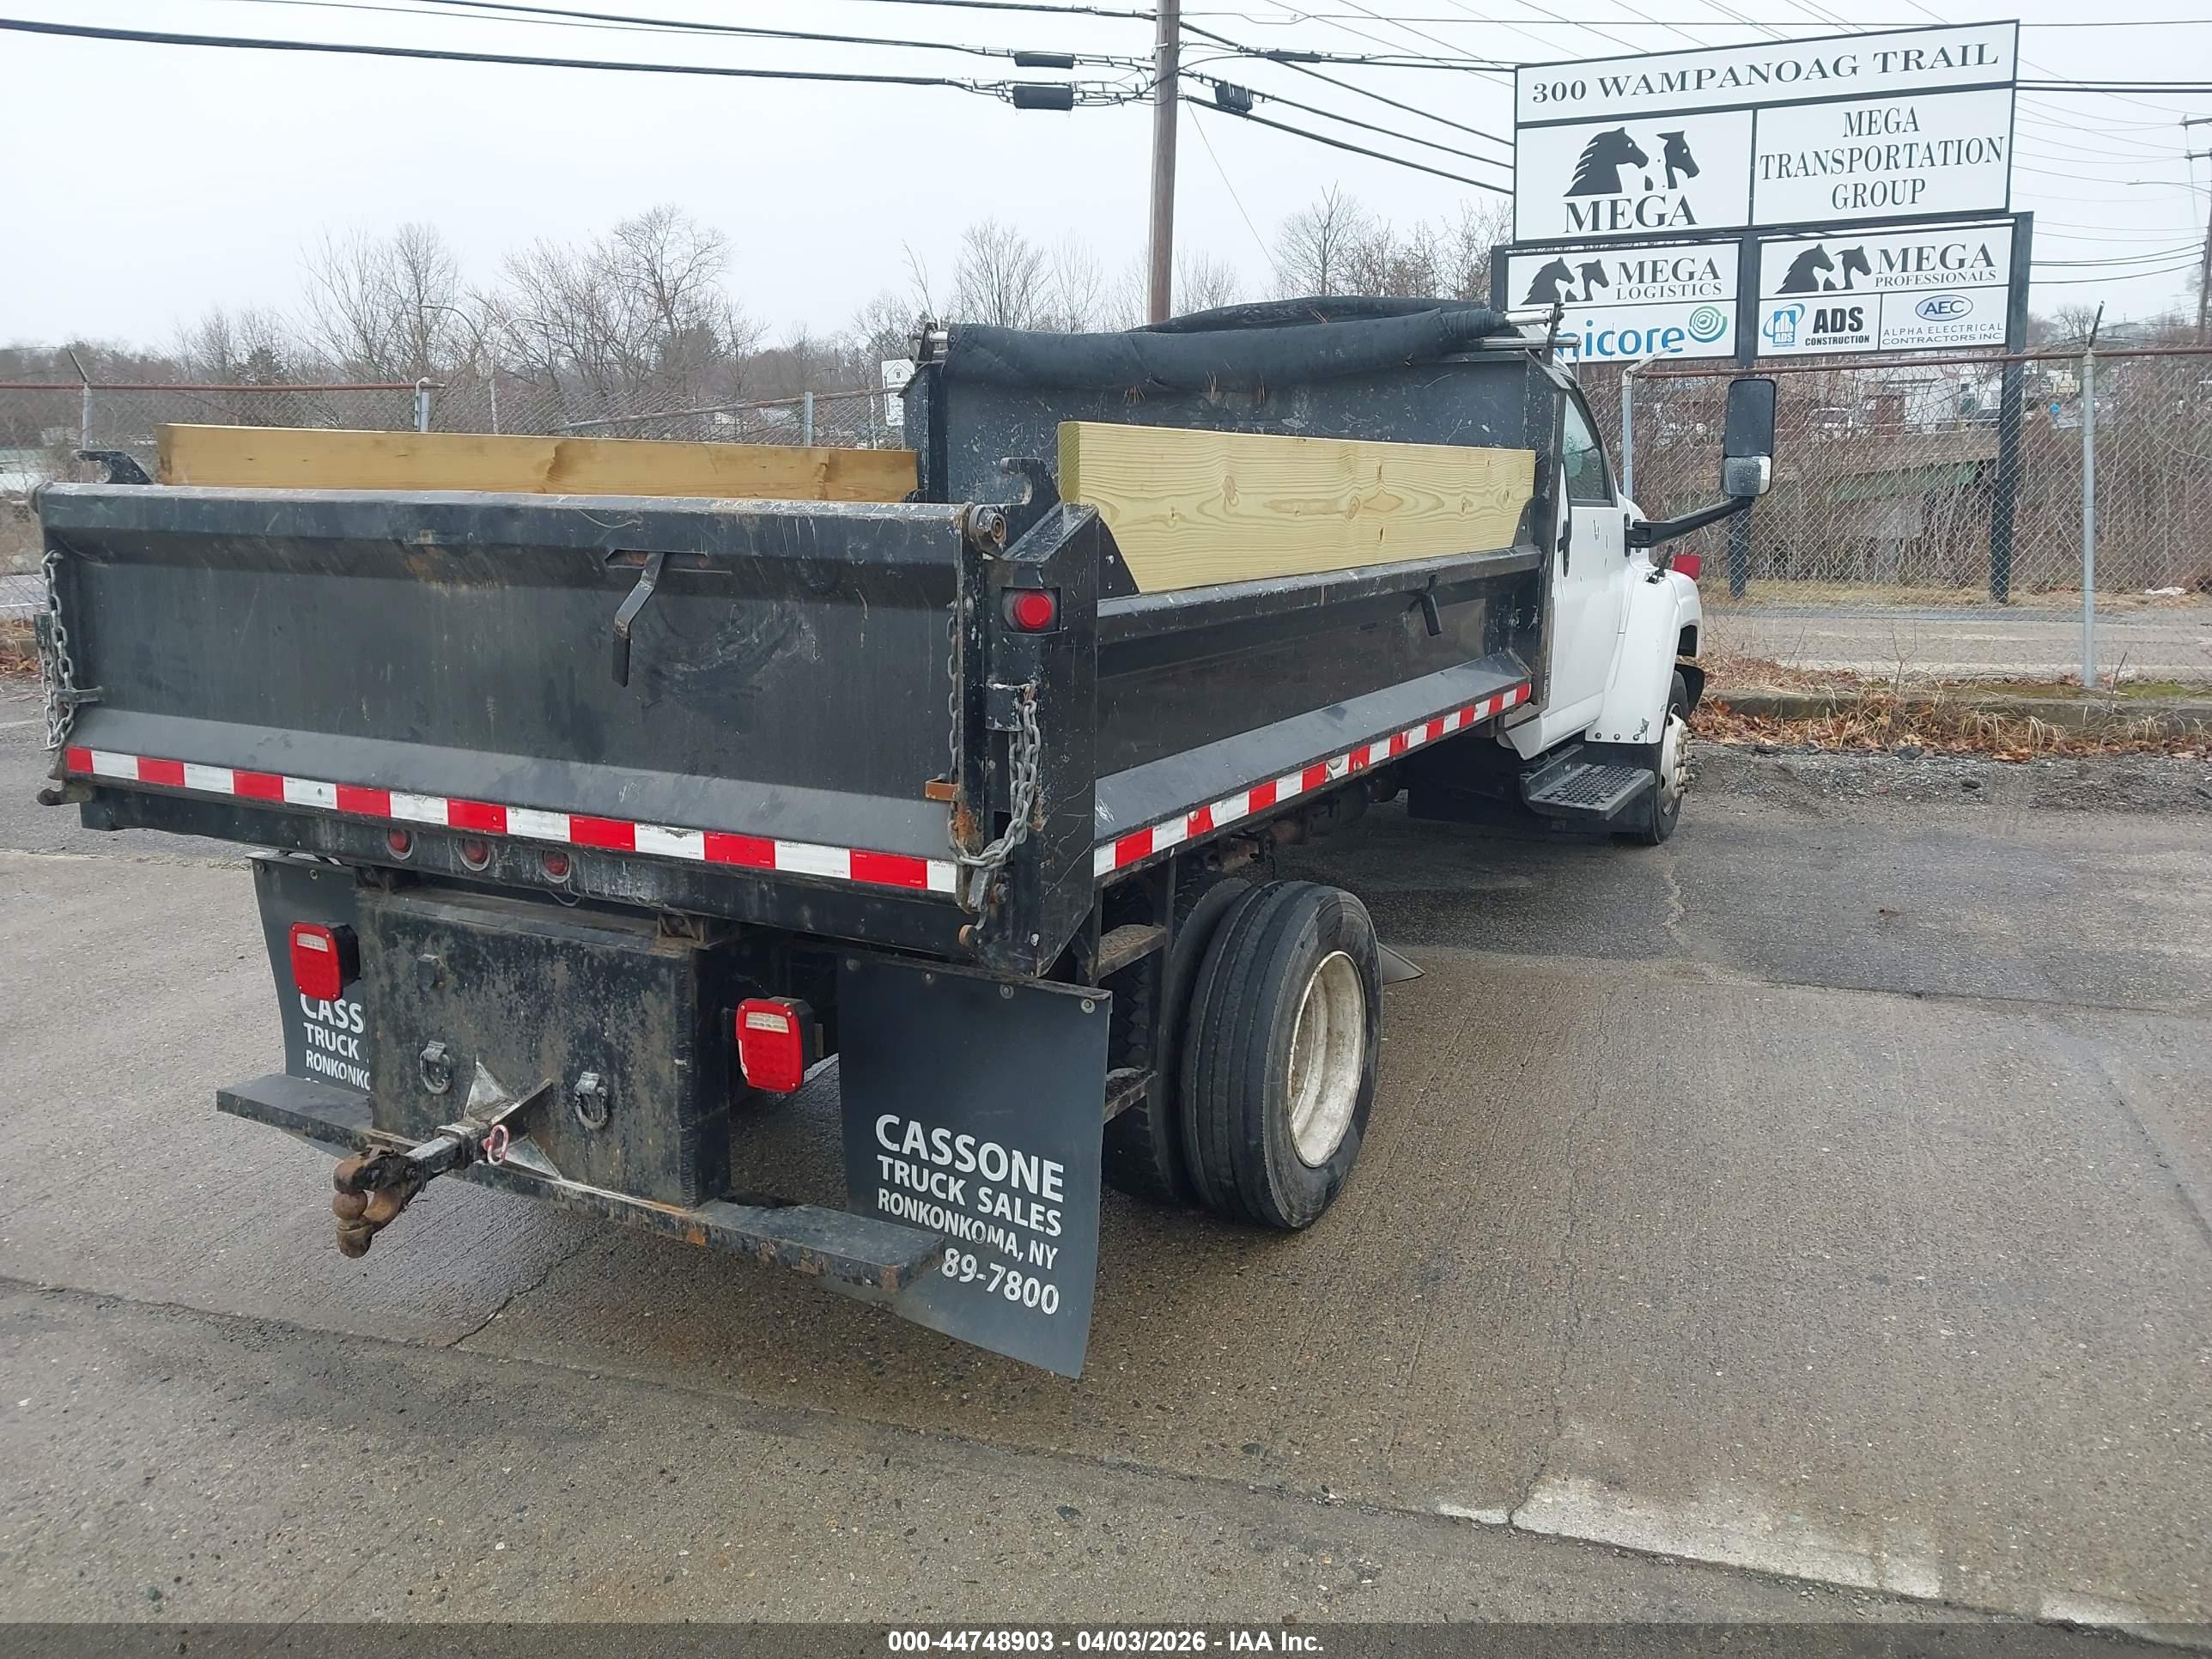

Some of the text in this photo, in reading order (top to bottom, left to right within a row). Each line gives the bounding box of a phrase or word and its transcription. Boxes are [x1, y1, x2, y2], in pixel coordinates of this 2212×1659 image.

[1532, 43, 1999, 103] 300 WAMPANOAG TRAIL
[1842, 106, 1920, 137] MEGA
[1759, 137, 2005, 180] TRANSPORTATION
[1832, 179, 1925, 210] GROUP
[1561, 194, 1699, 234] MEGA
[1616, 257, 1723, 286] MEGA
[1877, 242, 1996, 275] MEGA
[1617, 283, 1722, 301] LOGISTICS
[1875, 270, 1996, 288] PROFESSIONALS
[1813, 307, 1863, 334] ADS
[1923, 300, 1965, 315] AEC
[1556, 320, 1685, 357] nicore
[1805, 335, 1870, 346] CONSTRUCTION
[1882, 333, 1976, 345] CONTRACTORS
[1883, 323, 2003, 337] ALPHA ELECTRICAL
[300, 993, 365, 1034] CASS
[303, 1022, 360, 1060] TRUCK
[306, 1049, 371, 1091] RONKONKO
[875, 1114, 1064, 1202] CASSONE
[877, 1154, 1061, 1237] TRUCK SALES
[878, 1188, 1059, 1270] RONKONKOMA, NY
[935, 1248, 1060, 1315] 89-7800
